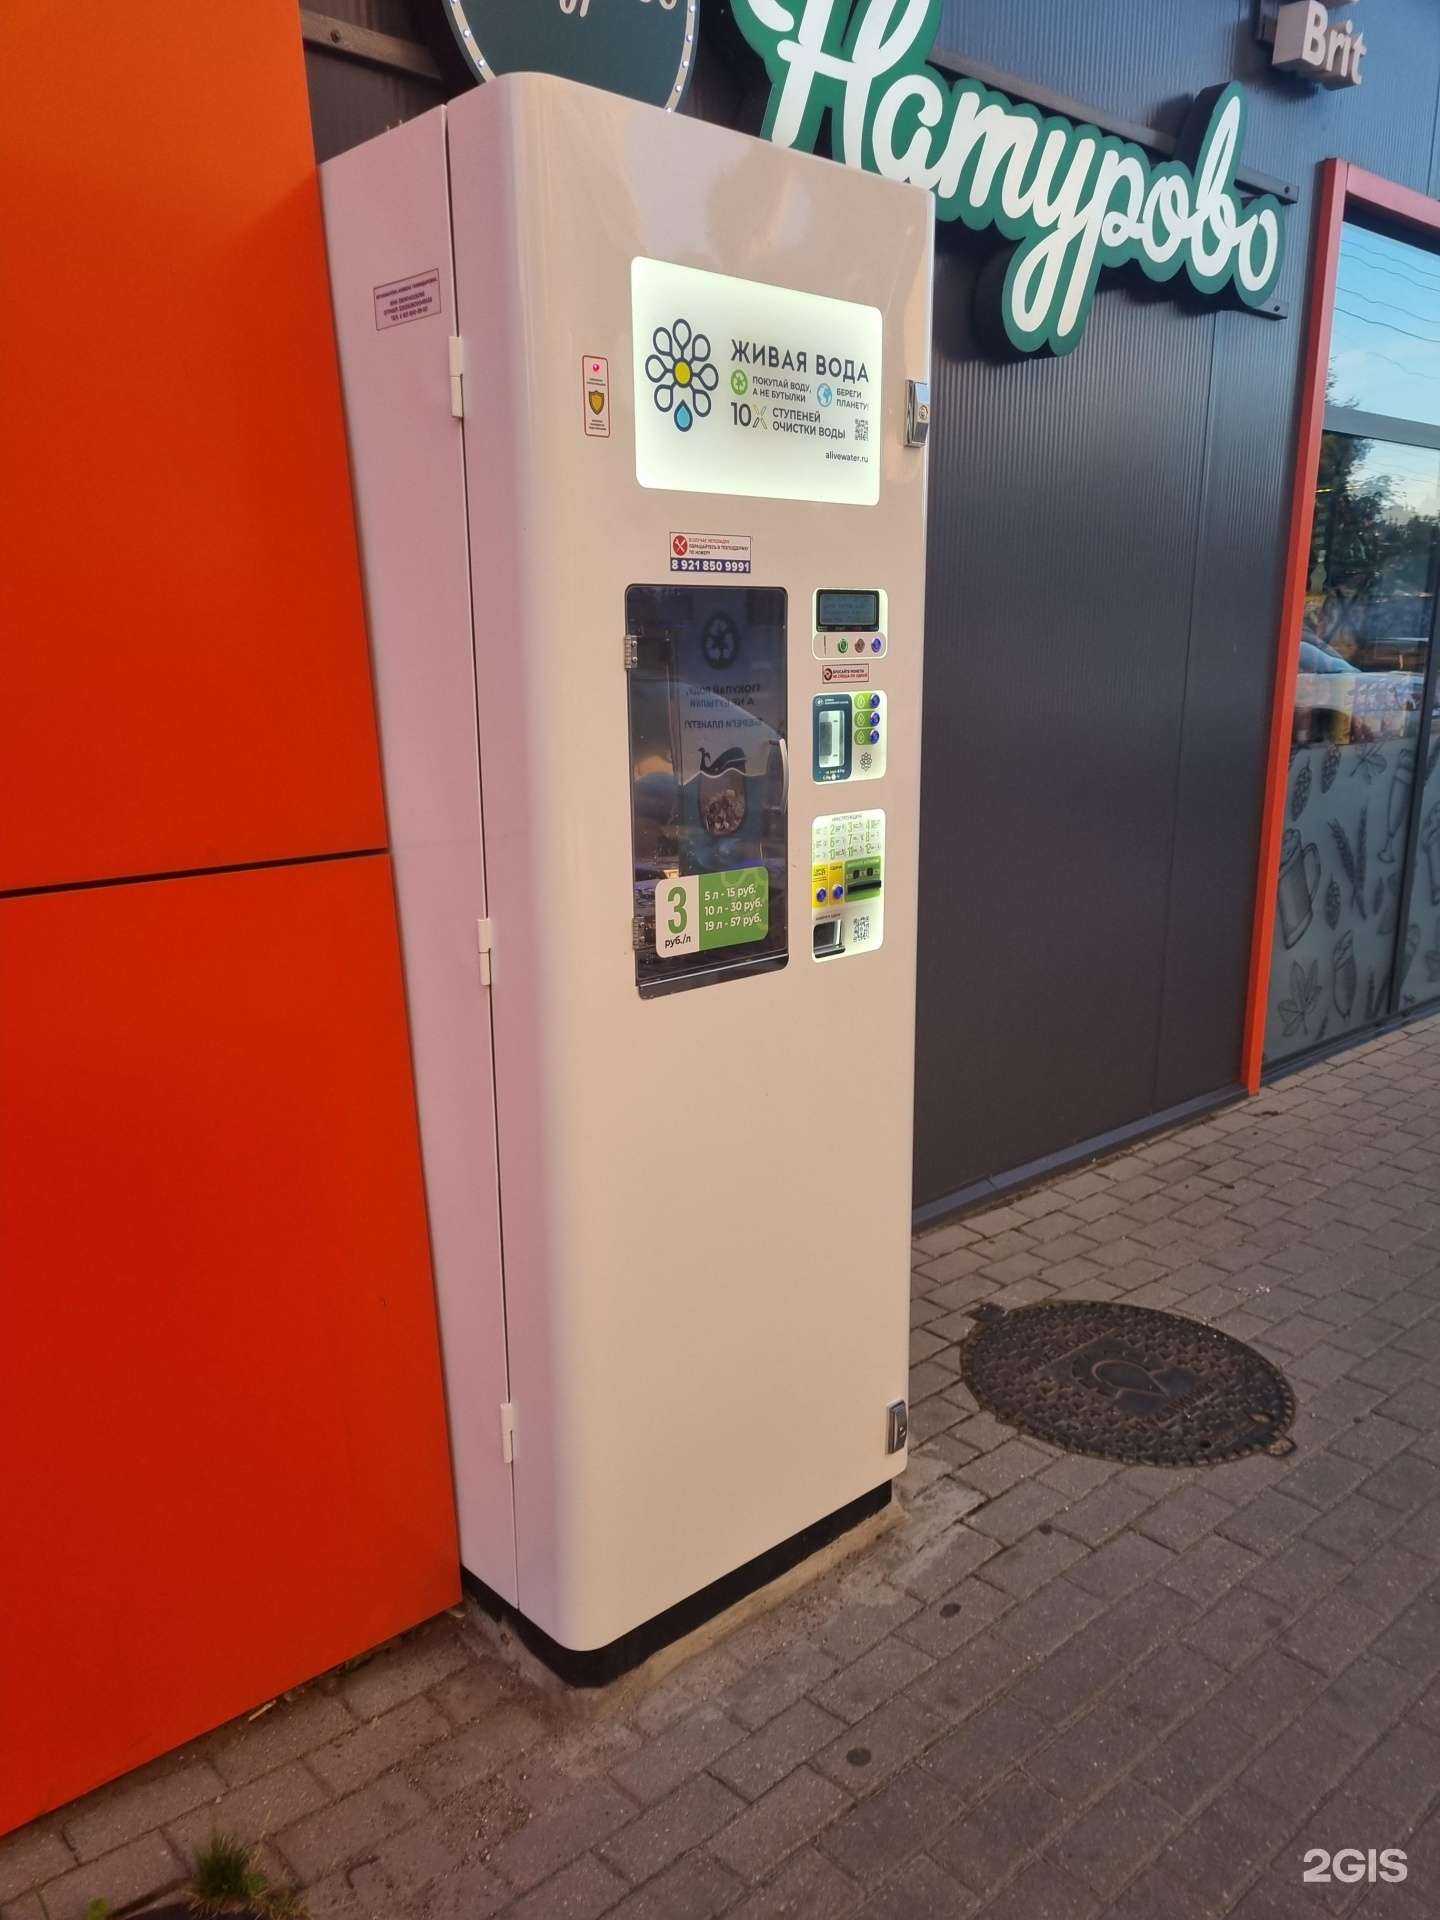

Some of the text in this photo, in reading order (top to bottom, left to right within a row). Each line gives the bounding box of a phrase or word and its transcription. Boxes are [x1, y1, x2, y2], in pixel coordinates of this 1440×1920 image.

[1302, 0, 1367, 85] Brit
[748, 0, 1278, 337] Натурово
[730, 339, 869, 383] ЖИВАЯ ВОДА
[752, 376, 789, 389] ПОКУПАЙ
[760, 389, 770, 398] НЕ
[771, 390, 806, 403] БУТЫЛКИ
[836, 388, 862, 399] БЕРЕГИ
[772, 407, 821, 423] СТУПЕНЕЙ
[772, 421, 846, 440] ОЧИСТКИ ВОДЫ
[825, 451, 869, 463] alivewater.ru
[671, 559, 750, 573] 8 921 850 9991
[704, 891, 711, 901] 5
[726, 887, 736, 898] 15
[737, 883, 756, 896] руб.
[667, 886, 688, 934] 3
[704, 905, 715, 916] 10
[716, 906, 723, 914] л
[730, 901, 742, 912] 30
[743, 897, 763, 912] руб.
[704, 921, 715, 931] 19
[716, 921, 723, 929] л
[730, 916, 741, 927] 57
[743, 913, 762, 926] руб.
[664, 934, 692, 948] руб./л
